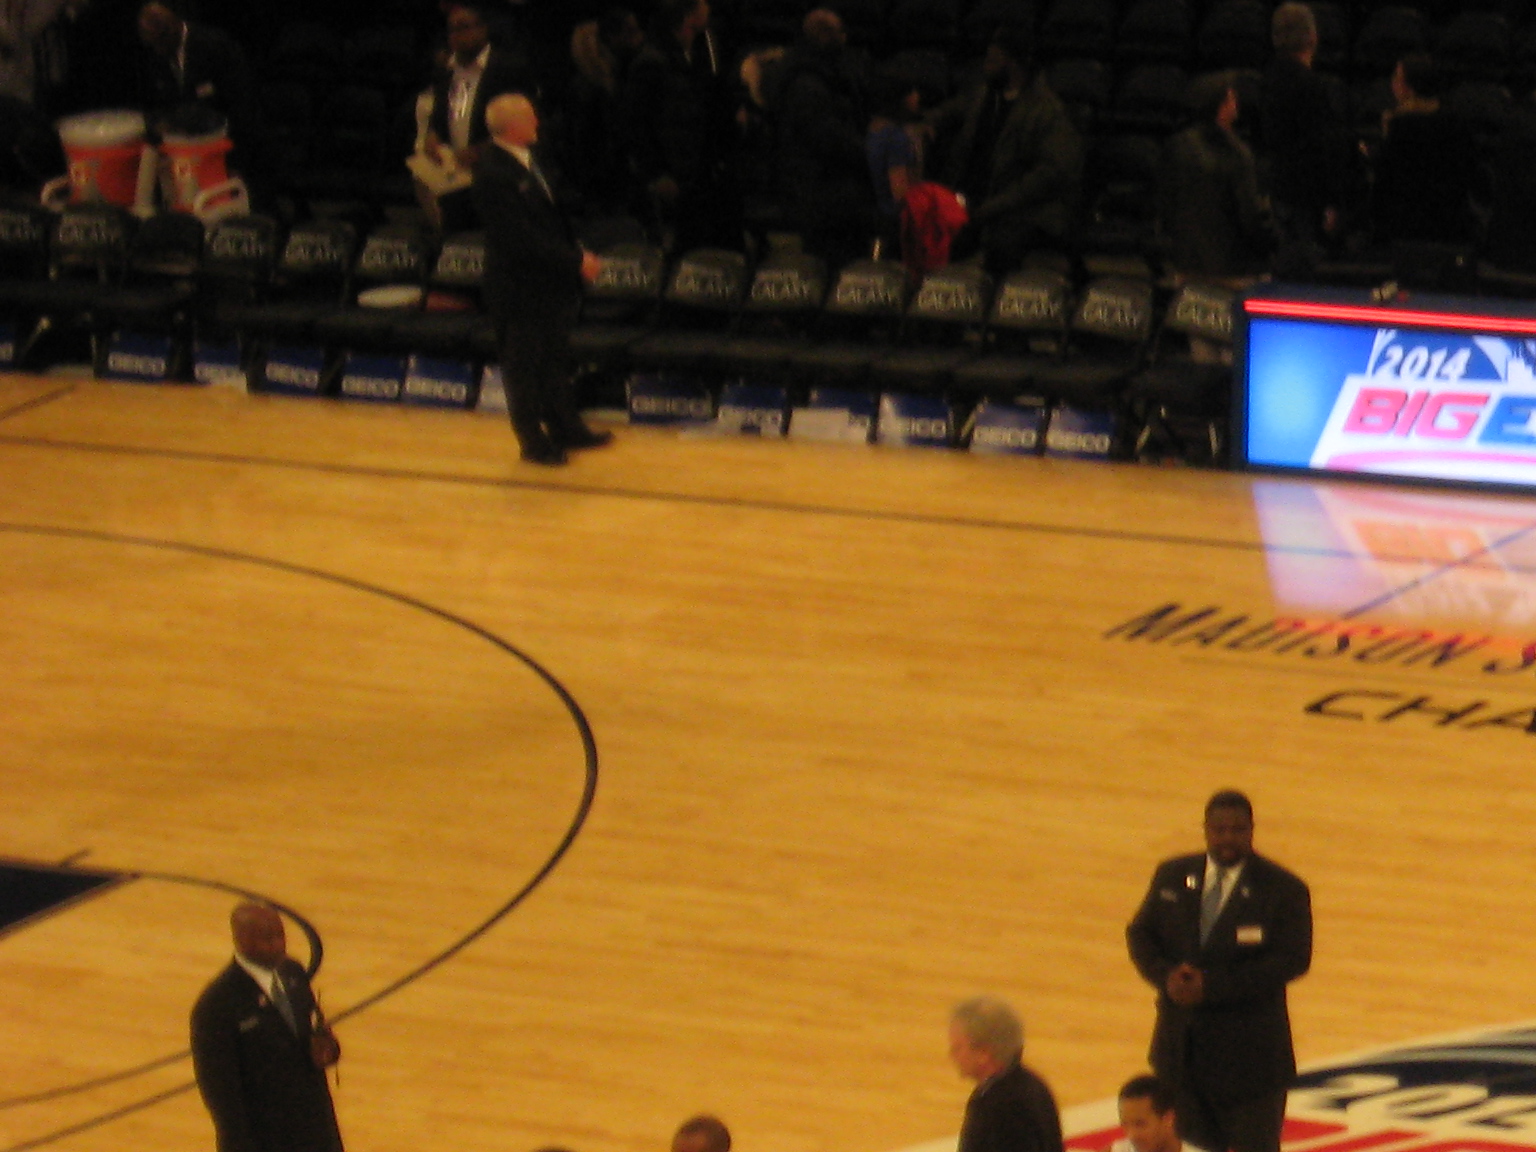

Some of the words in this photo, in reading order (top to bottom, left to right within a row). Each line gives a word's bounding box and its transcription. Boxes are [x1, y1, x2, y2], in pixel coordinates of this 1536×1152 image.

[1374, 346, 1471, 382] 2014
[1342, 387, 1491, 441] BIG
[1103, 603, 1490, 669] MADISON
